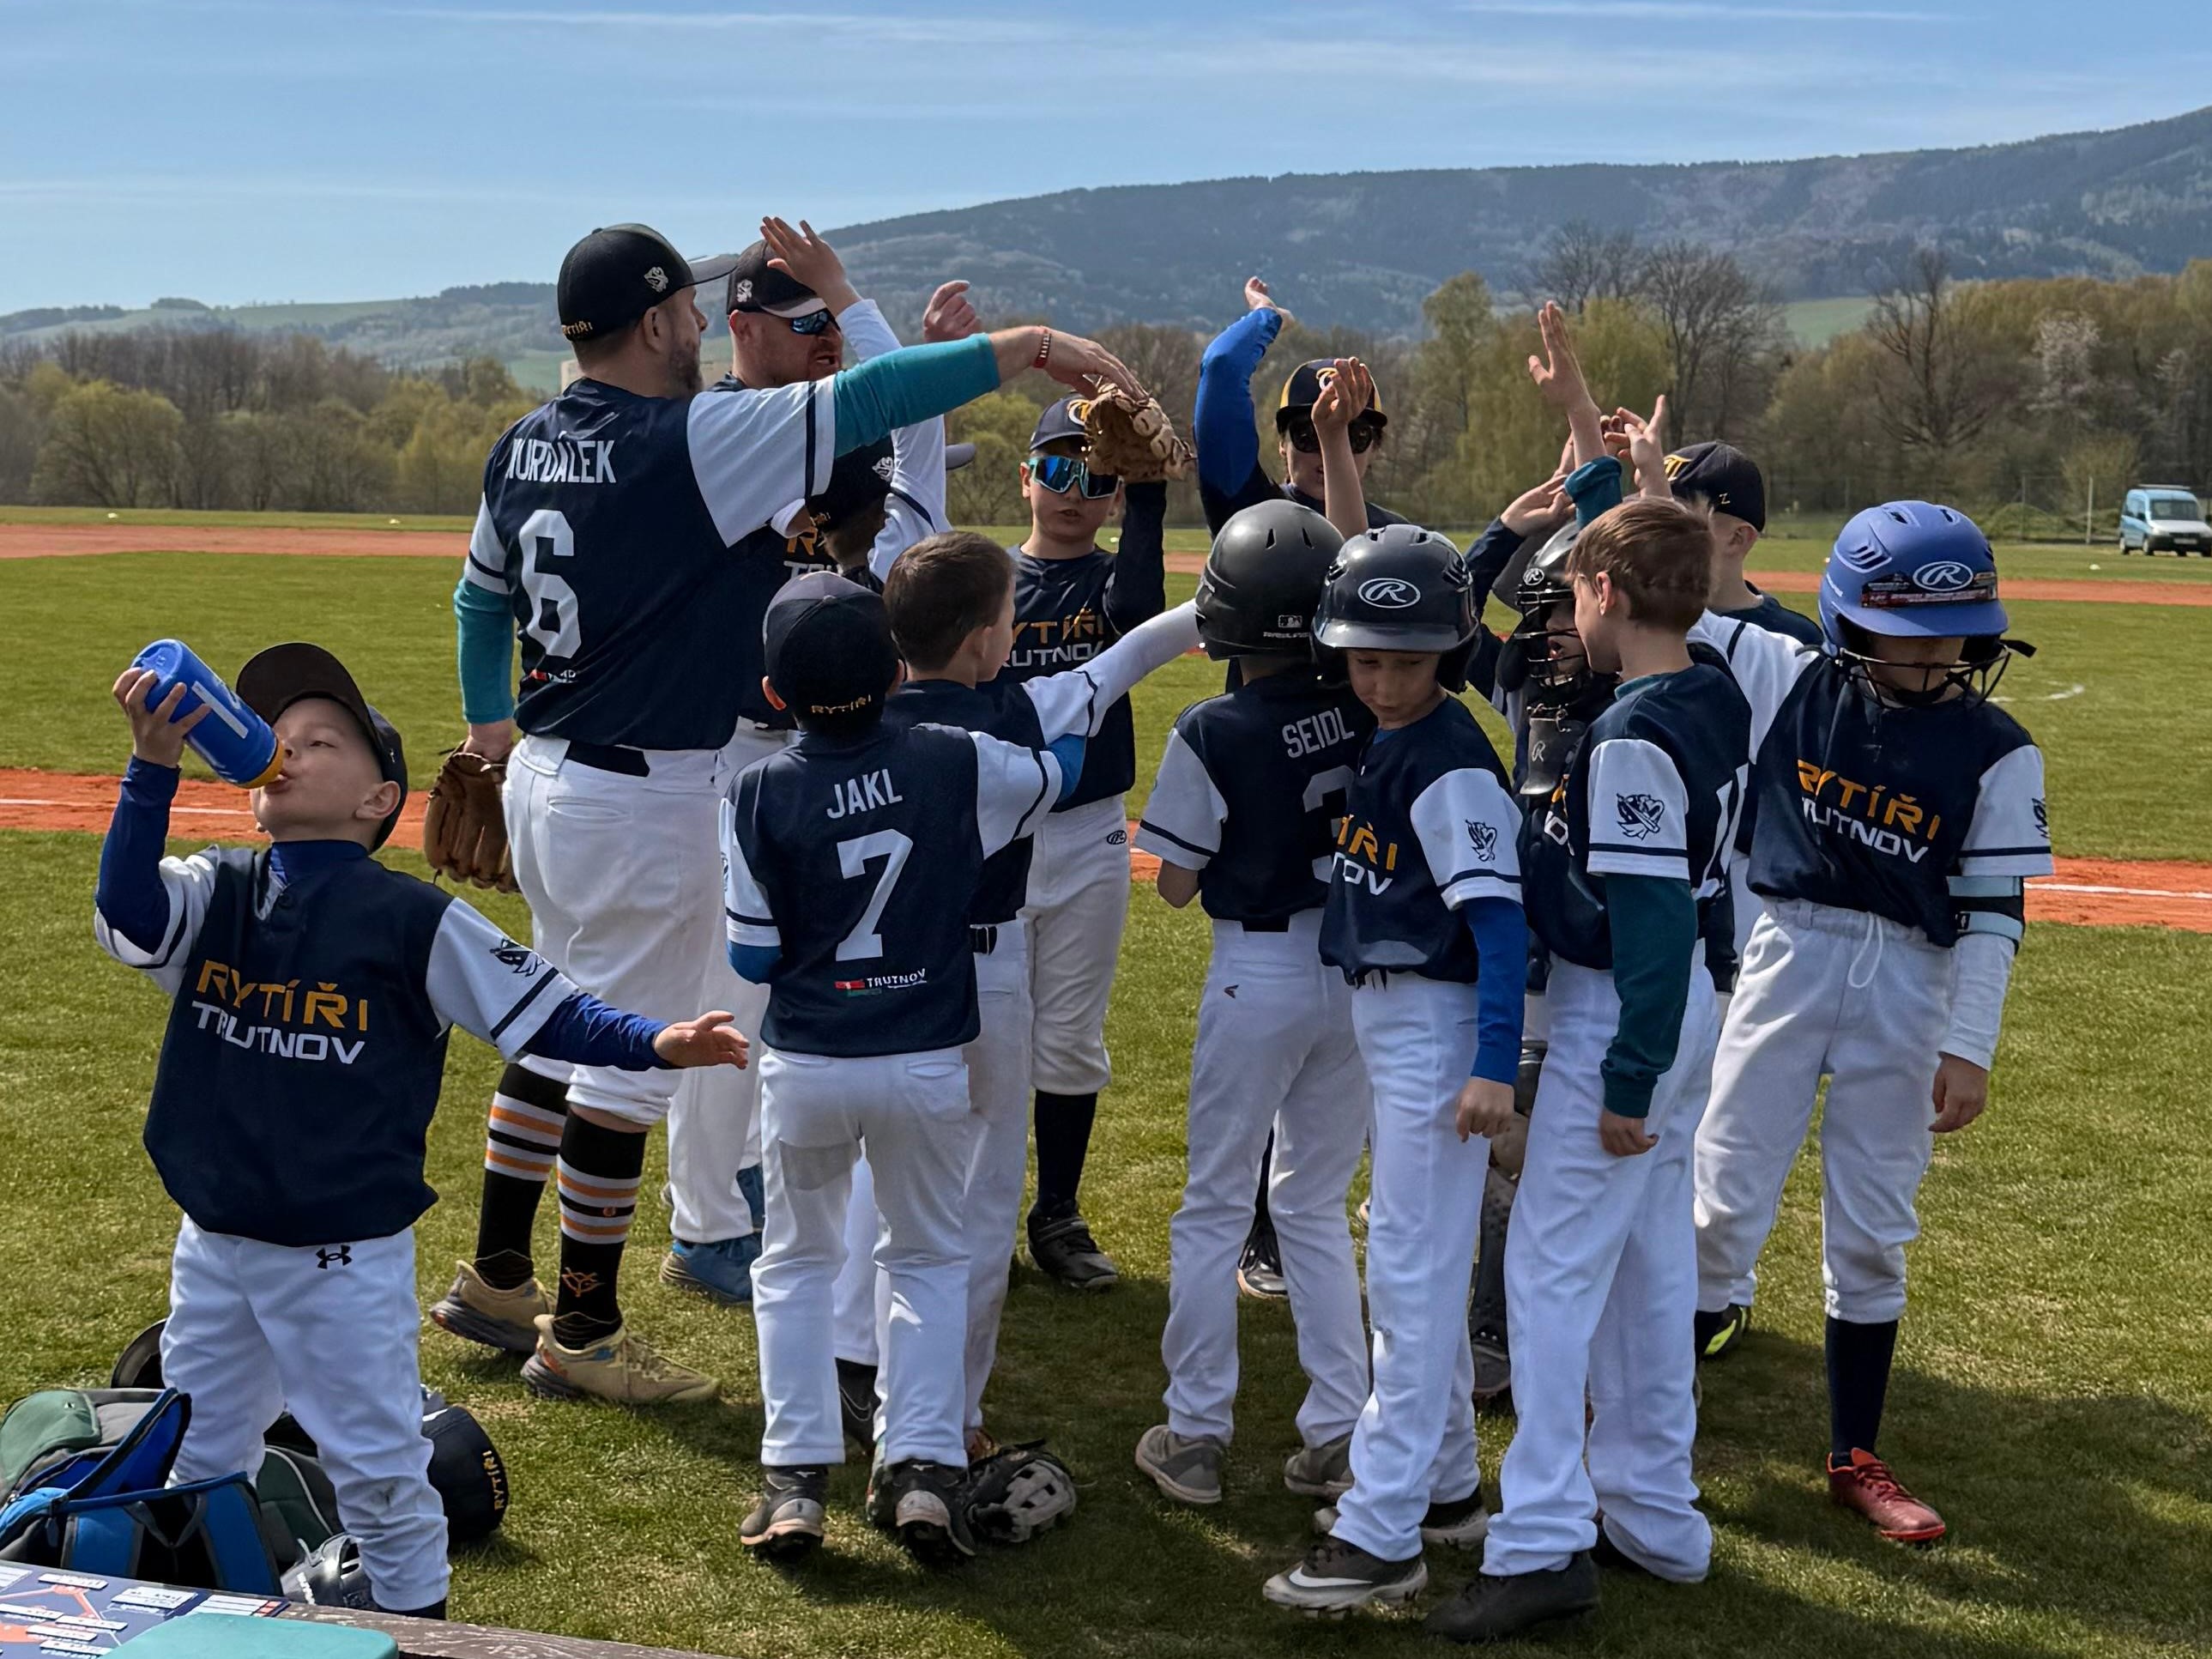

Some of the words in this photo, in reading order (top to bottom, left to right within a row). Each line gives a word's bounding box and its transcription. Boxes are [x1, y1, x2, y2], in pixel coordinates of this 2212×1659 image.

[519, 509, 582, 659] 6
[1282, 707, 1355, 759] SEIDL
[826, 769, 903, 819] JAKL
[835, 828, 913, 961] 7
[196, 960, 369, 1032] RYTÍŘI
[867, 968, 926, 988] TRUTNOV
[192, 1001, 366, 1064] TRUTNOV
